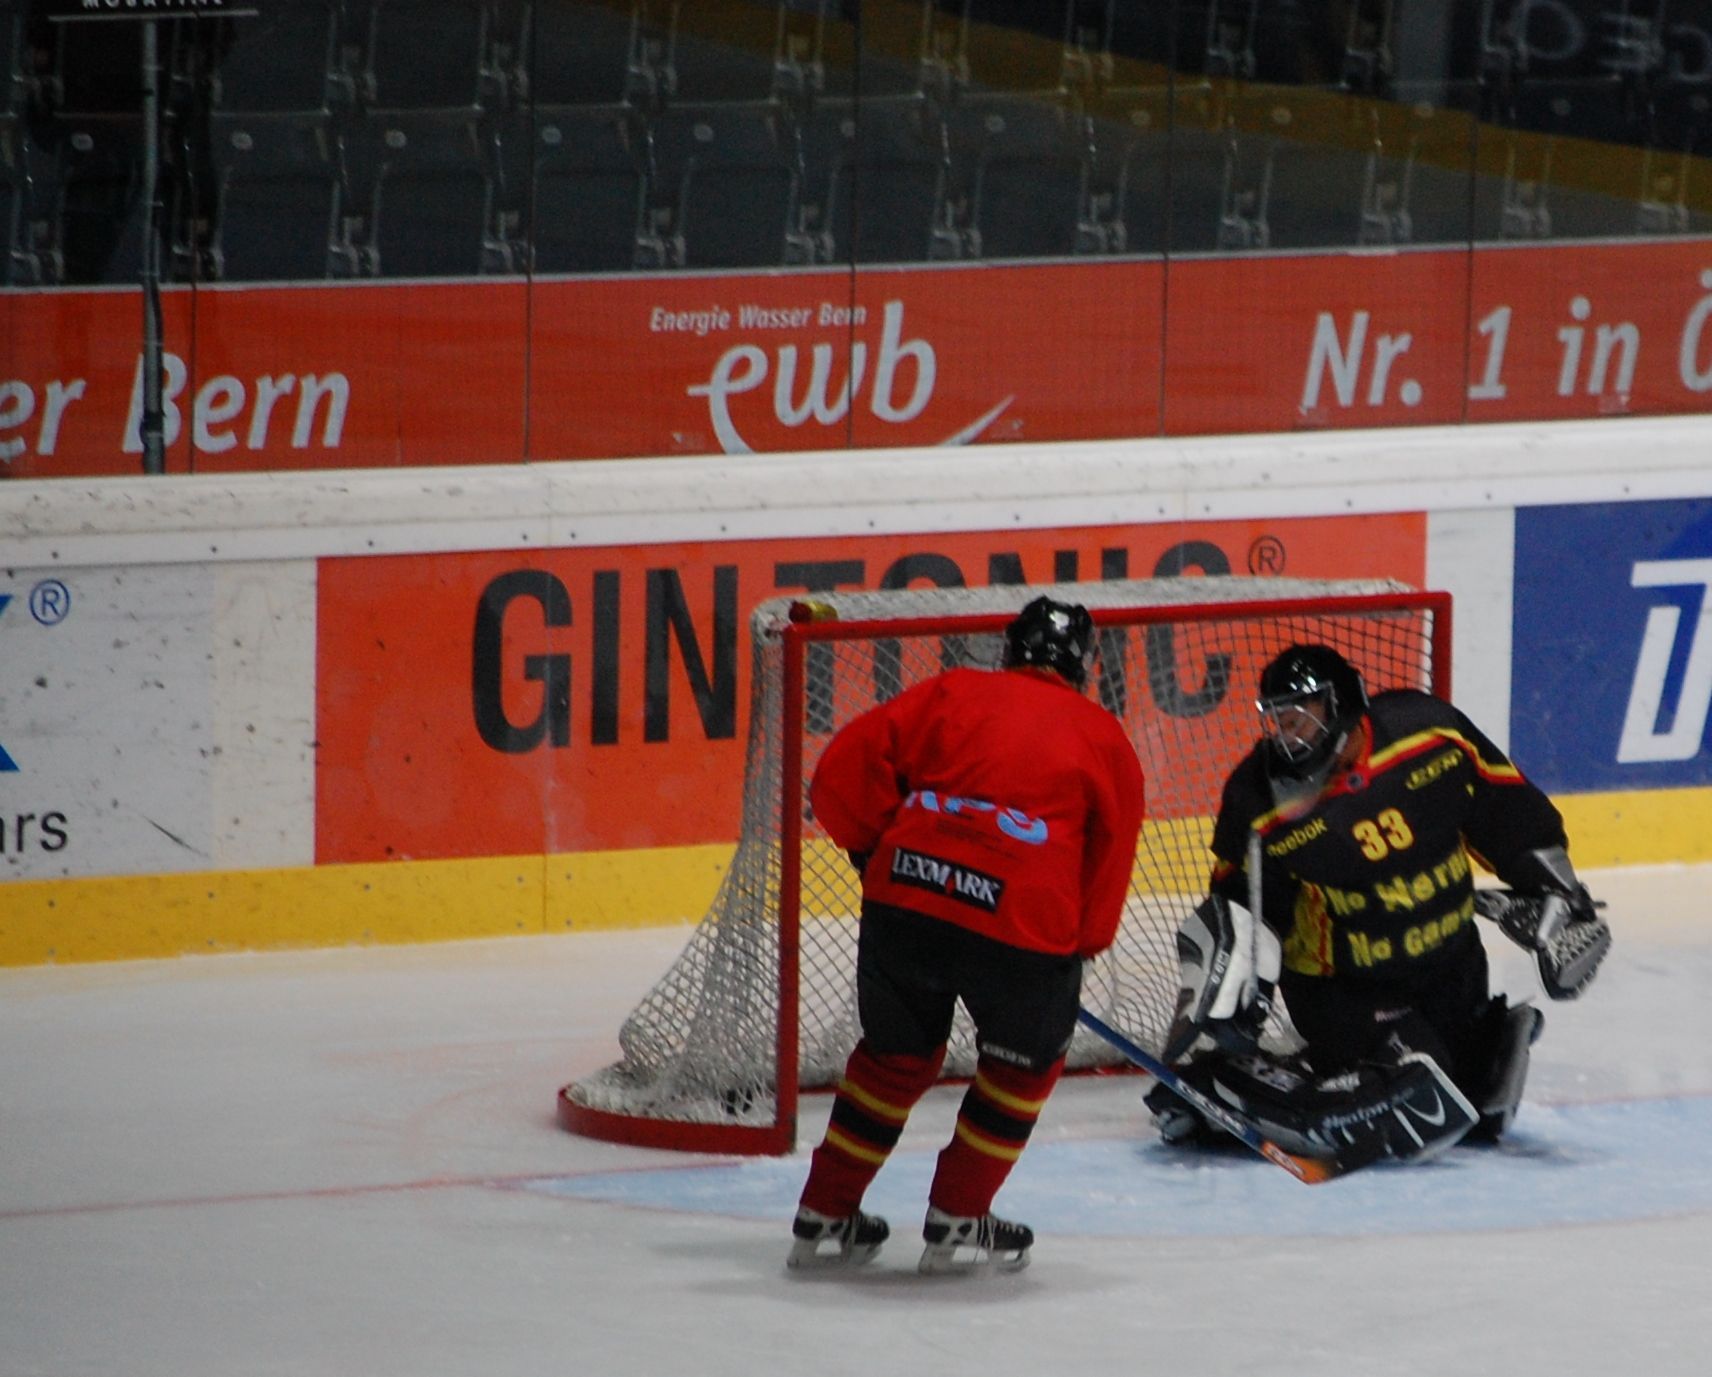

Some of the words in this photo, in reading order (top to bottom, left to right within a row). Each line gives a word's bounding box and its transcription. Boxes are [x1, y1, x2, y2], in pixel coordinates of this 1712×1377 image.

[650, 307, 730, 336] Energie
[739, 304, 812, 329] Wasser
[819, 303, 867, 326] Bern
[1301, 311, 1422, 408] Nr.
[1468, 306, 1512, 399] 1
[1558, 296, 1640, 396] in
[122, 351, 349, 454] Bern
[687, 301, 937, 454] ewb
[471, 566, 738, 754] GIN
[0, 811, 69, 852] rs
[1352, 807, 1414, 862] 33
[892, 848, 1001, 906] LEXMARK
